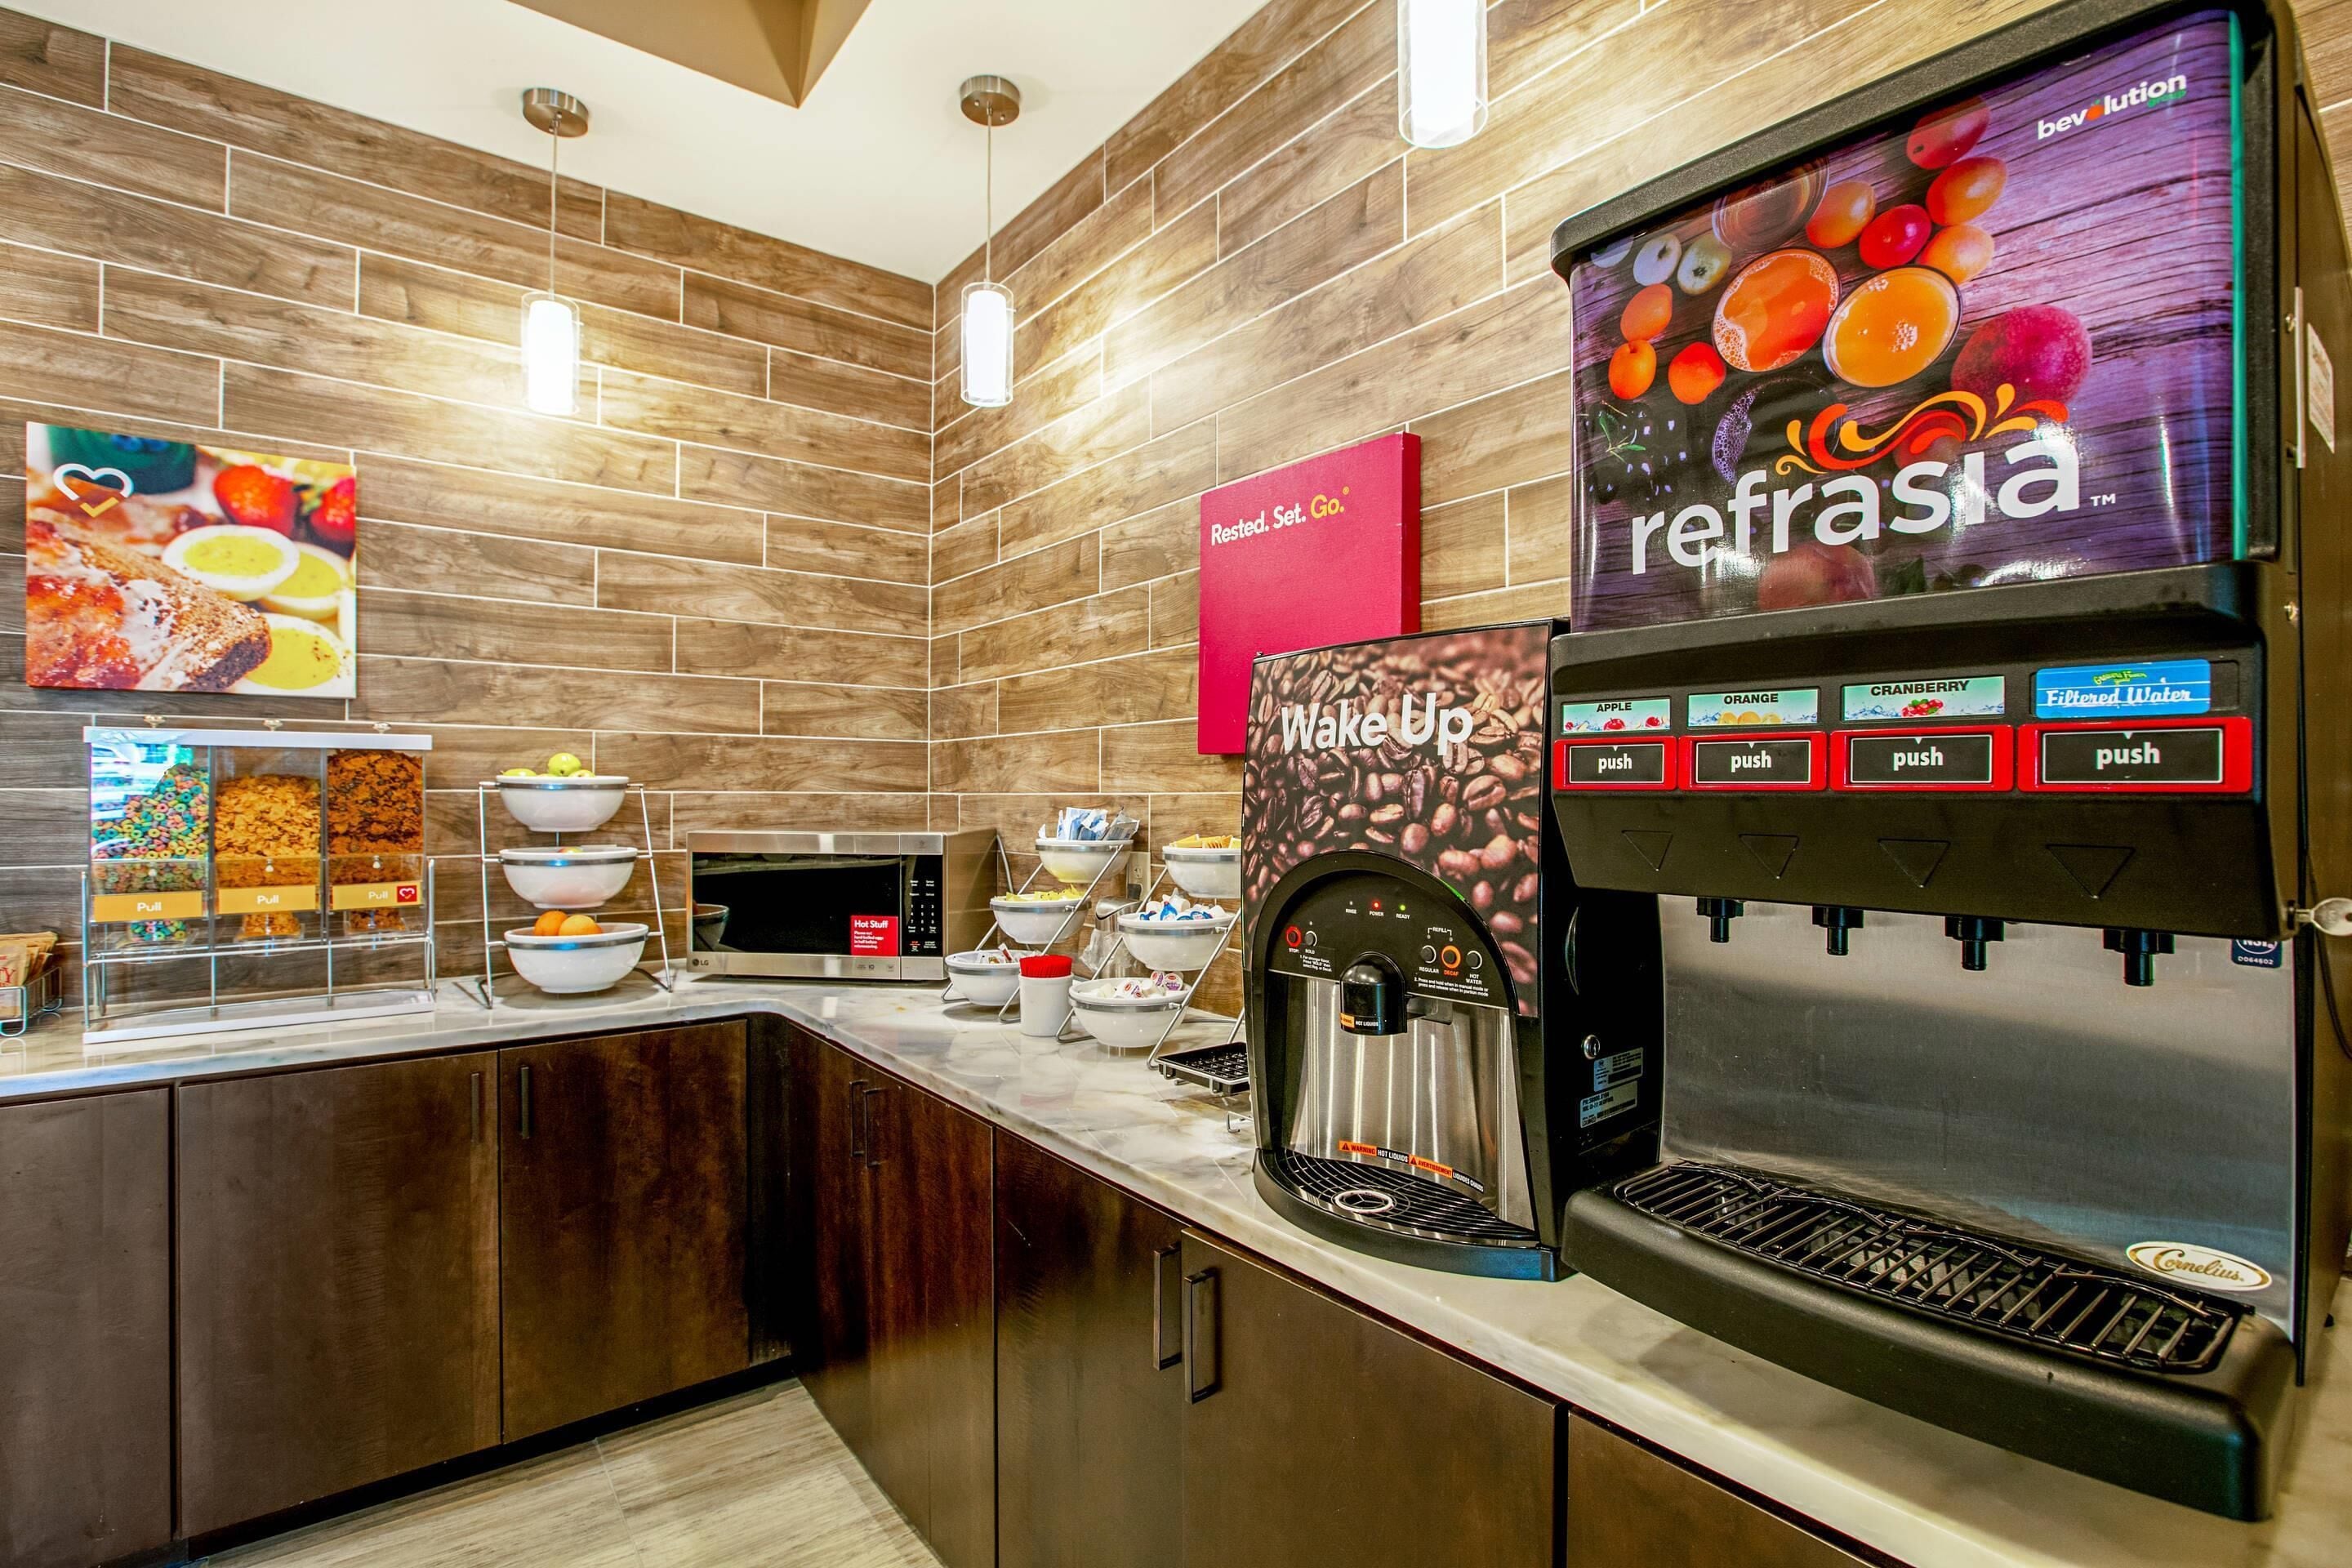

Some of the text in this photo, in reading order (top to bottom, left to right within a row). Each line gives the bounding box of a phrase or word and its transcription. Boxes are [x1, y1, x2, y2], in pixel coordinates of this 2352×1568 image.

[2038, 74, 2186, 140] bevolution
[1632, 436, 2080, 575] refrasia
[1211, 510, 1269, 546] Rested.
[1272, 502, 1307, 530] Set.
[1870, 679, 1970, 697] CRANBERRY
[2046, 685, 2192, 707] Filtered Water
[1597, 702, 1633, 713] APPLE
[1723, 693, 1779, 706] ORANGE
[1281, 692, 1474, 756] Wake Up
[1597, 753, 1633, 773] push
[1731, 751, 1772, 773] push
[1892, 746, 1944, 771] push
[2096, 742, 2162, 771] push
[257, 895, 279, 905] Pull
[368, 891, 389, 900] Pull
[137, 902, 162, 912] Pull
[854, 920, 889, 929] Hot Stuff
[1351, 1144, 1408, 1163] WARNING HOT LIQUIDS
[1418, 1160, 1452, 1176] AVERTISSEMENT
[1453, 1170, 1469, 1185] LIQUIDES
[2153, 1249, 2239, 1281] Cornelius
